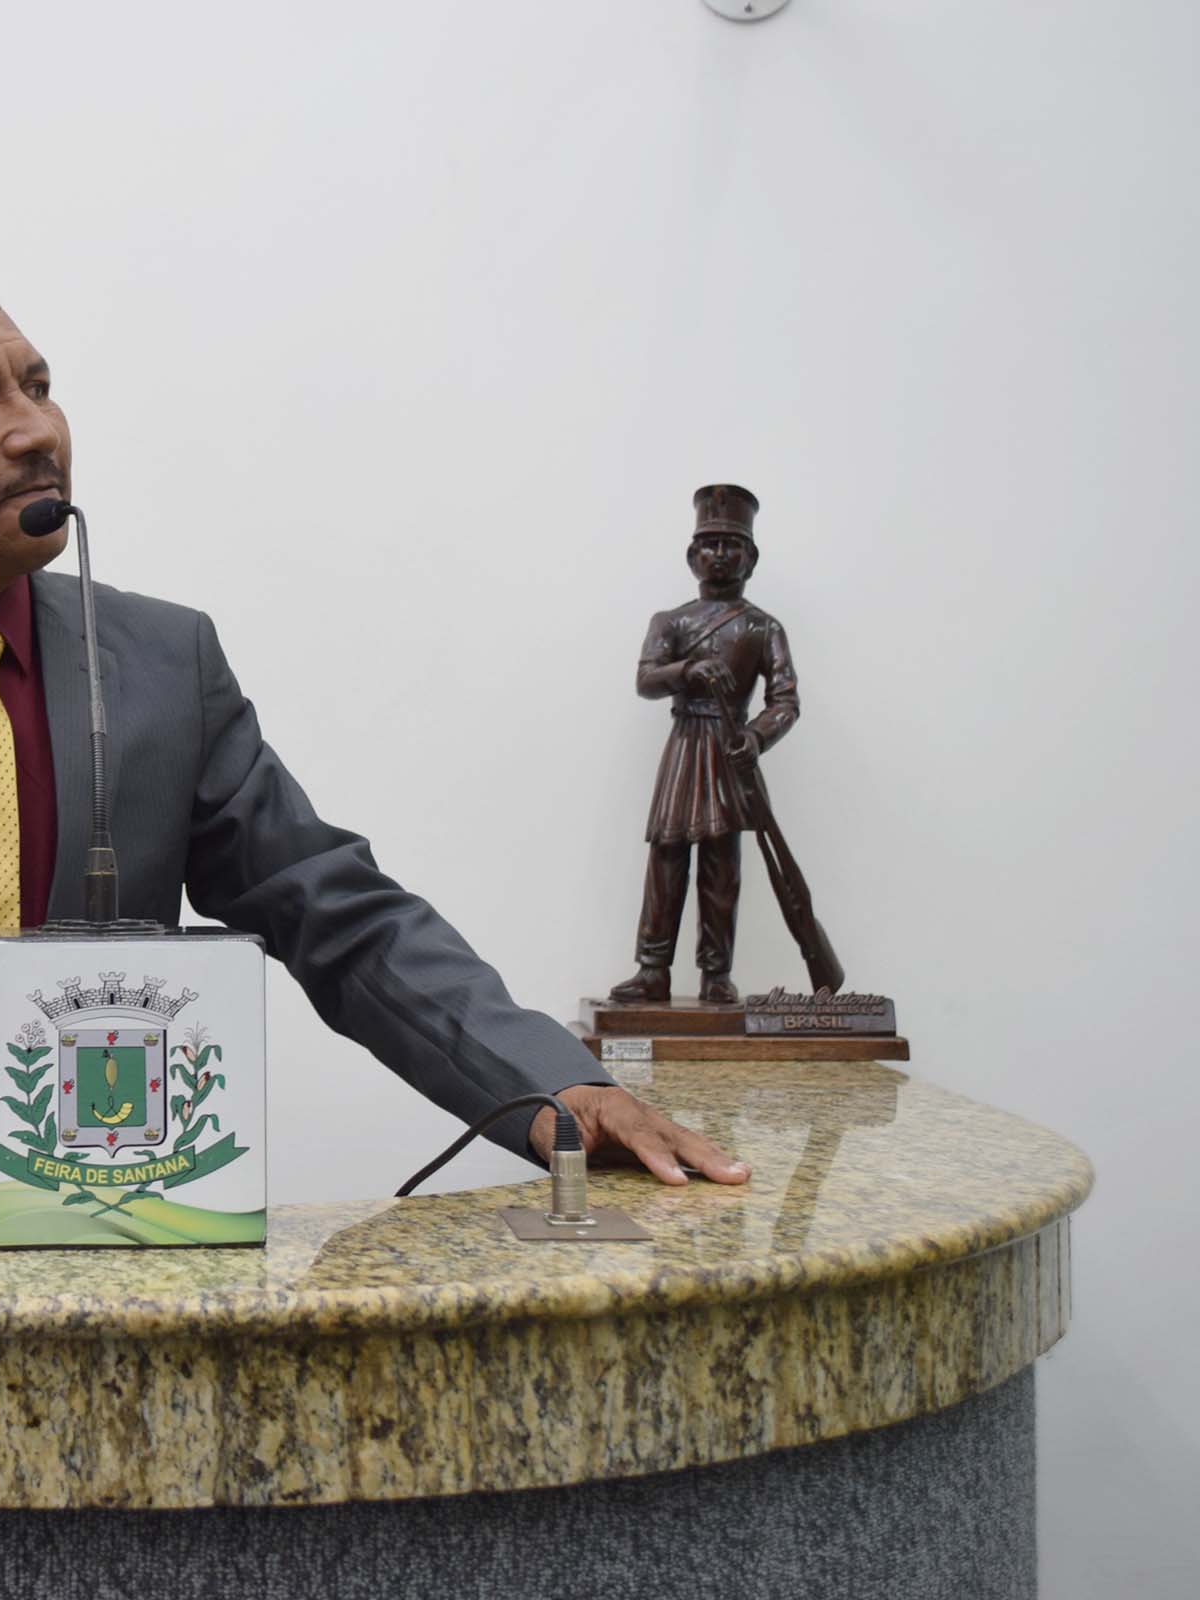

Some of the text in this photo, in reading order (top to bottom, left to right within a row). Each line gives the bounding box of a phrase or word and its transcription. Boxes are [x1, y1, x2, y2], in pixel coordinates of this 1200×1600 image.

[784, 1015, 849, 1029] BRASIL
[34, 1154, 190, 1185] FEIRA DE SANTANA
